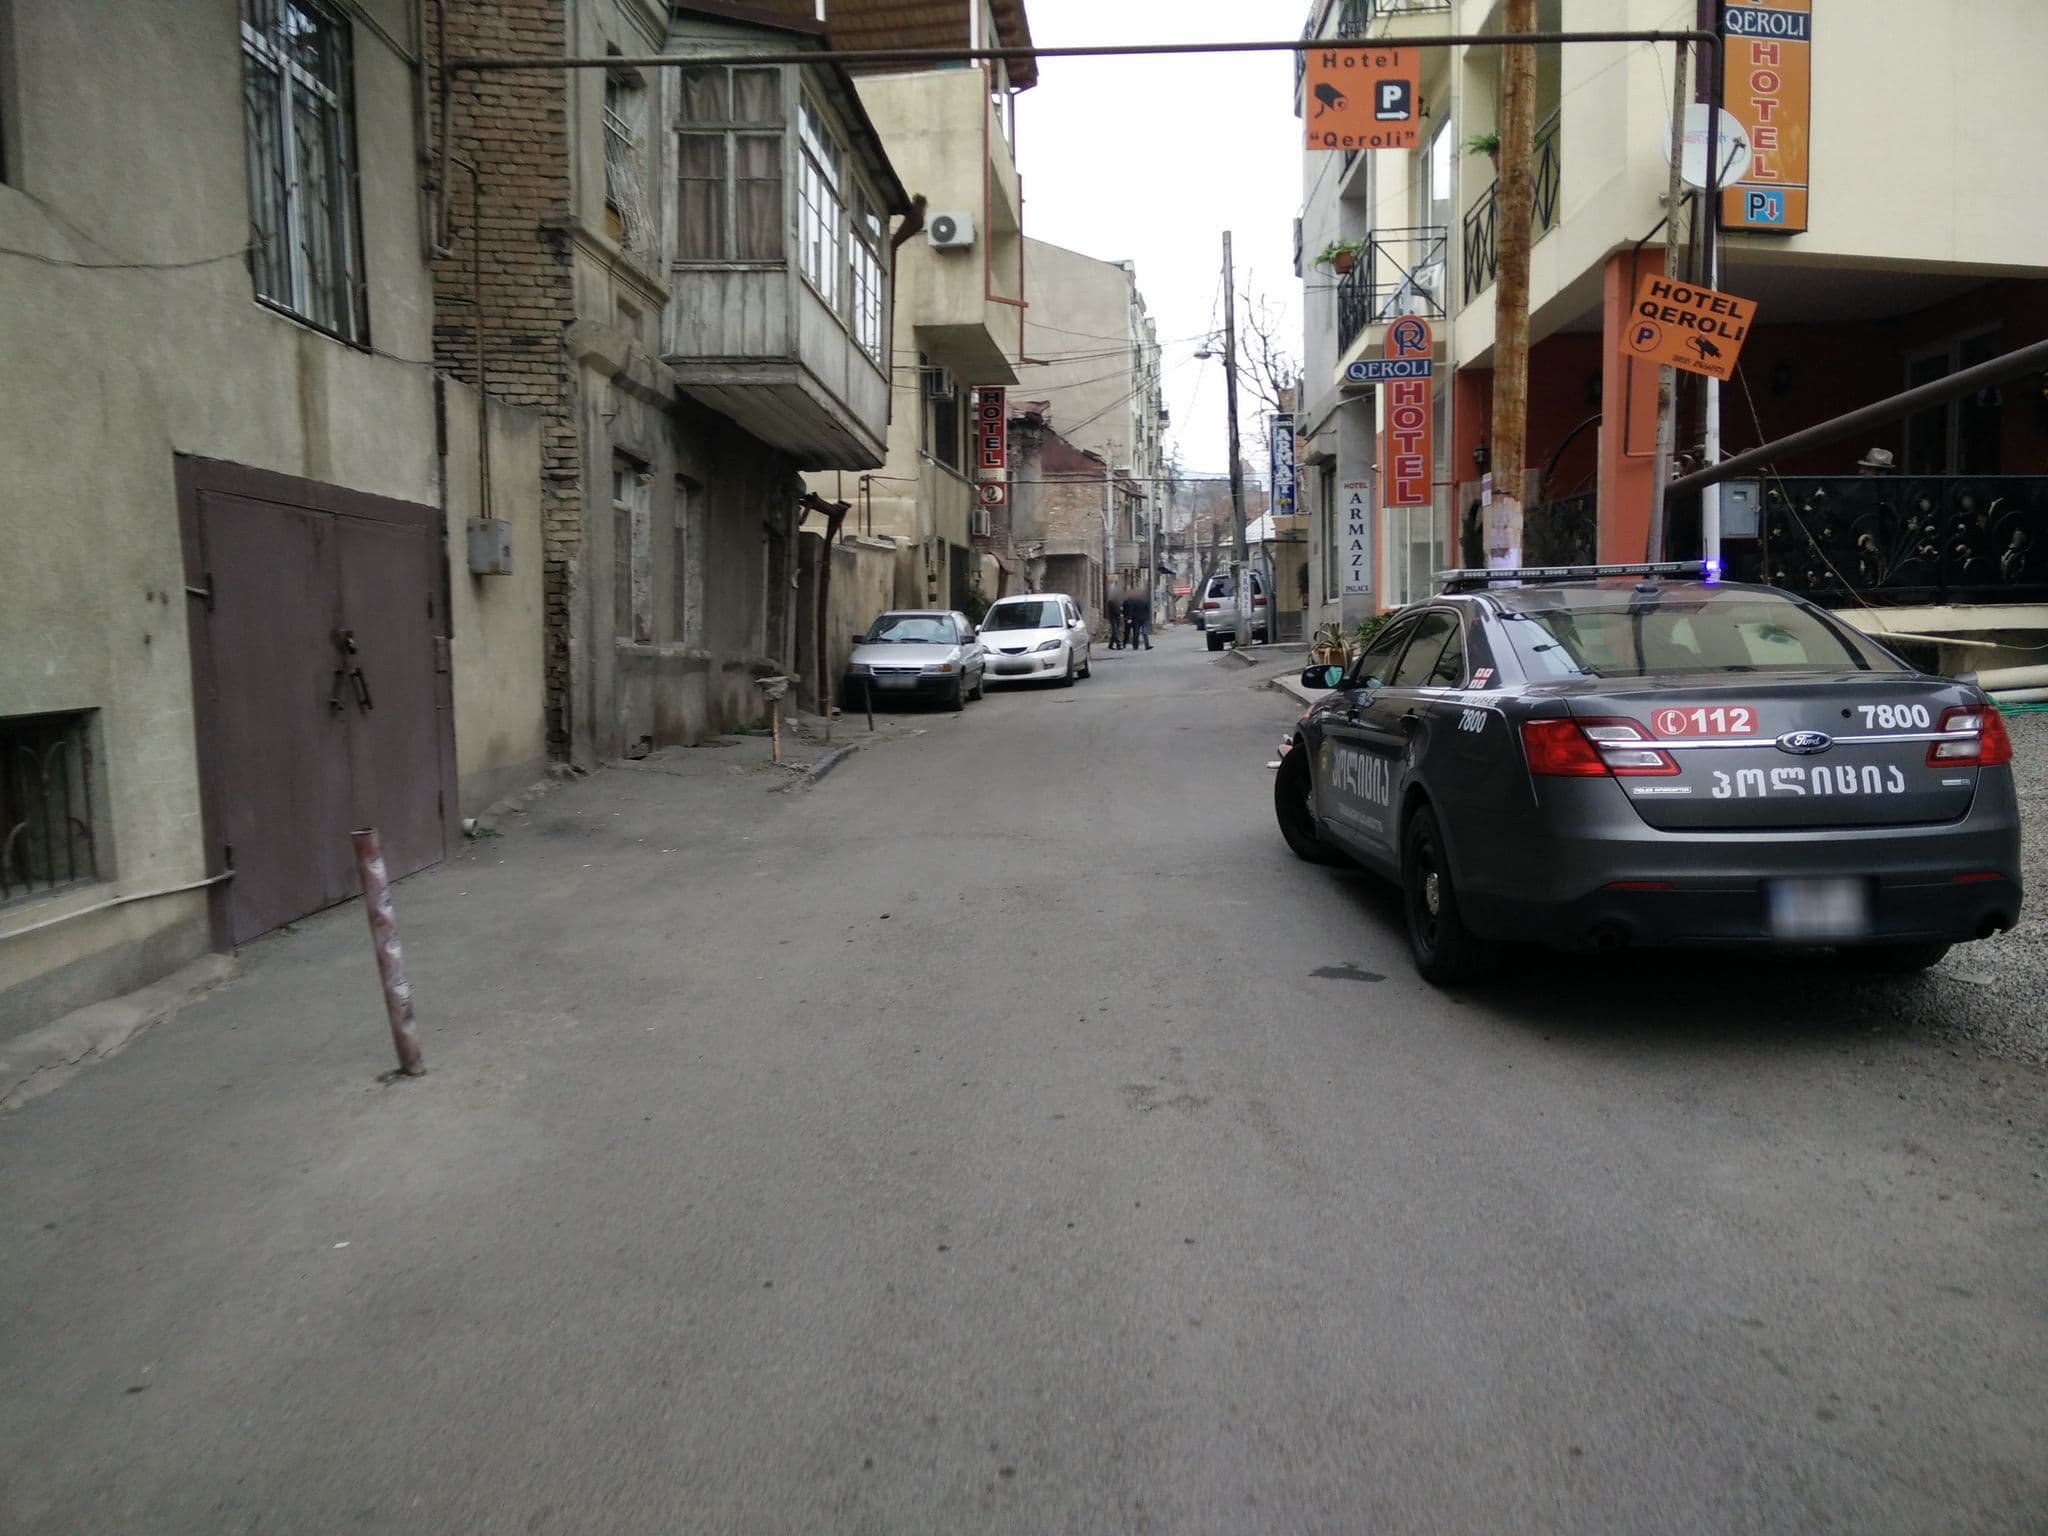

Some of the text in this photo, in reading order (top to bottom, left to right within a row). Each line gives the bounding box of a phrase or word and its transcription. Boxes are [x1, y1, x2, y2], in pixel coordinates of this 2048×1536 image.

[1725, 9, 1805, 36] QEROLI
[1323, 52, 1399, 68] Hotel
[1382, 85, 1402, 109] P
[1751, 41, 1780, 179] HOTEL
[1651, 281, 1743, 319] HOTEL
[1640, 301, 1744, 341] QEROLI
[1350, 361, 1430, 379] QEROLI
[982, 391, 1001, 465] HOTEL
[1392, 381, 1425, 504] HOTEL
[1348, 492, 1364, 581] ARMAZI
[1458, 709, 1487, 734] 7800
[1691, 708, 1751, 733] 112
[1857, 704, 1930, 729] 7800
[1794, 734, 1821, 746] Ford
[1712, 765, 1905, 799] პოლიცია
